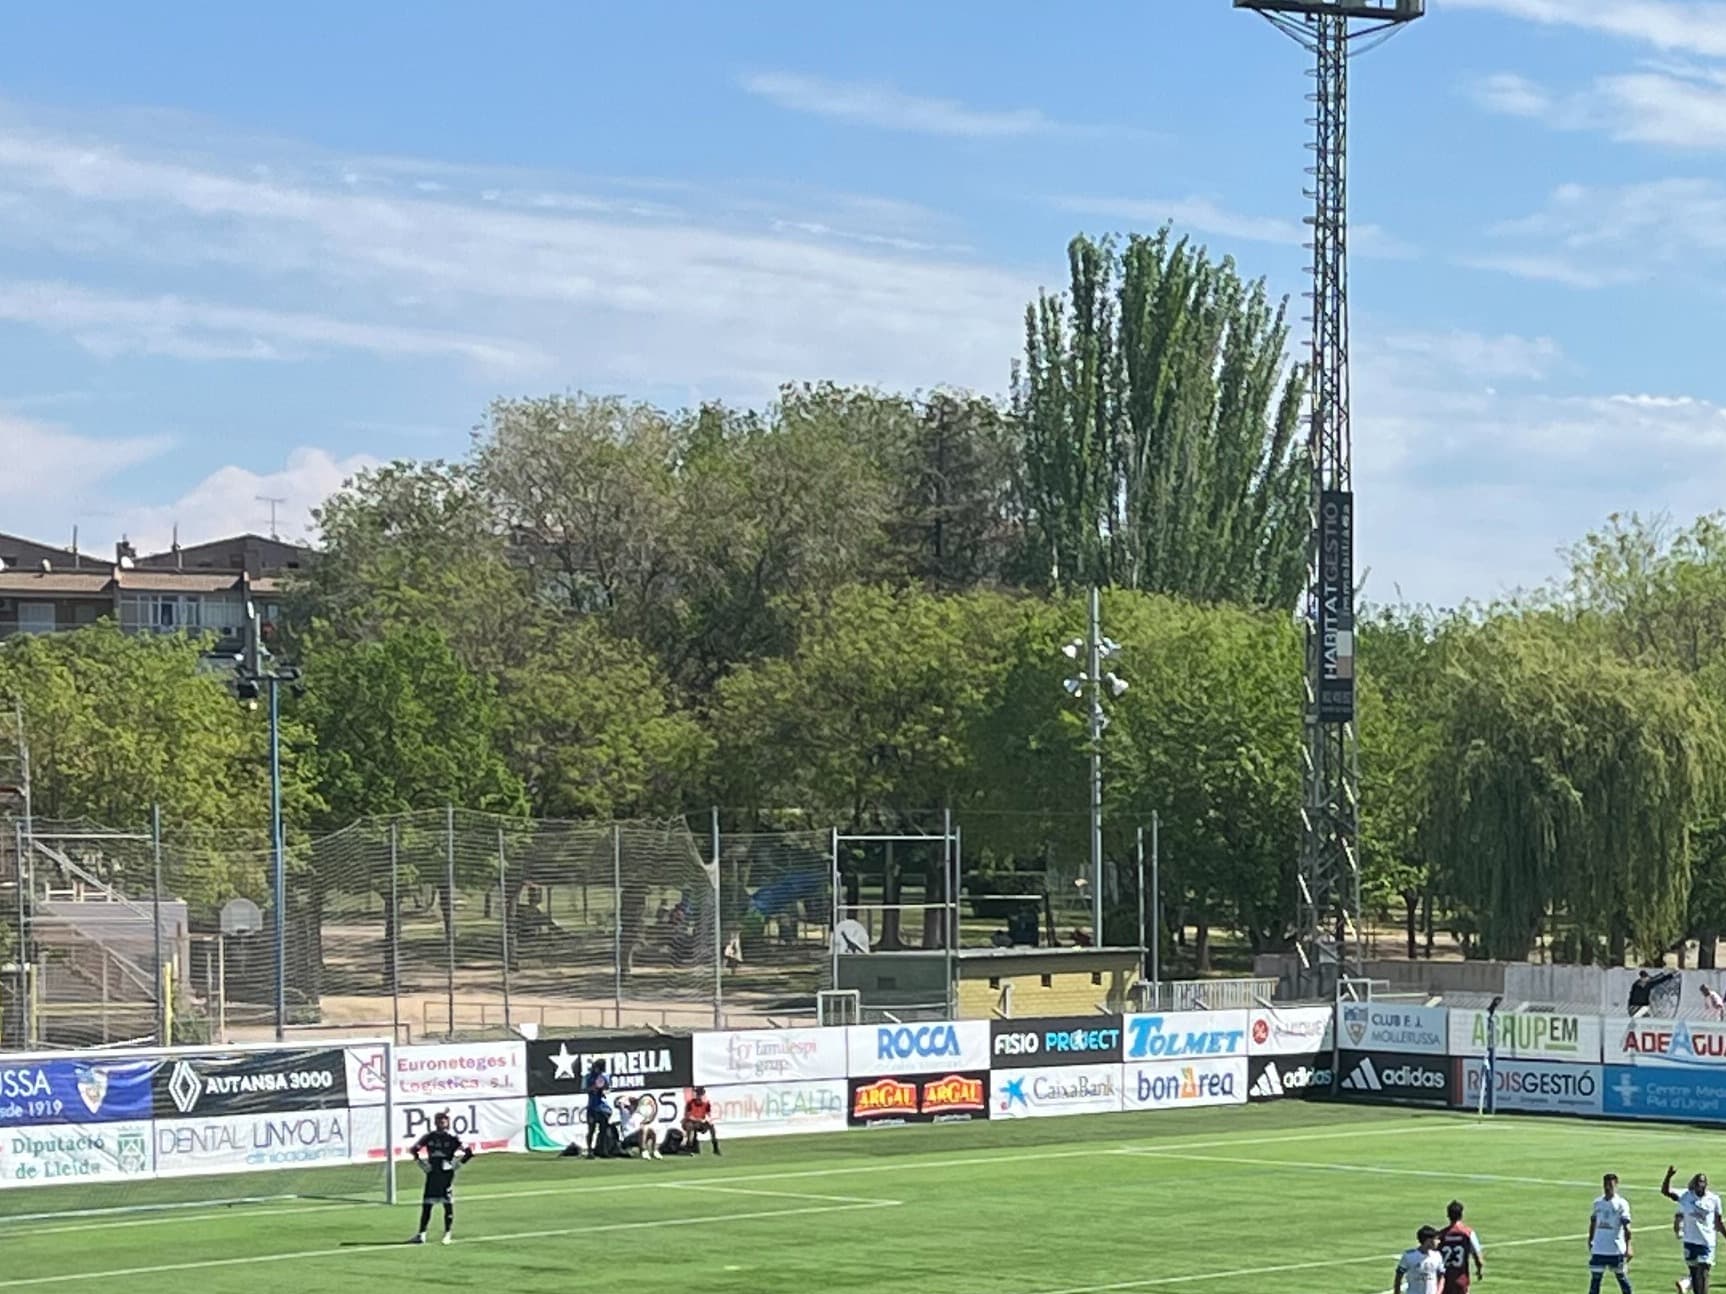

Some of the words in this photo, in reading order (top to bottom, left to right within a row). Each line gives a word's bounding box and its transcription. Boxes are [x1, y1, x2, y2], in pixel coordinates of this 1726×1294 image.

[877, 1025, 961, 1060] ROCCA
[580, 1050, 673, 1076] ETRELLA
[0, 1069, 53, 1098] SSA
[205, 1072, 289, 1094] AUTANSA
[290, 1070, 334, 1089] 3000
[1032, 1072, 1115, 1100] CaixaBank
[1283, 1066, 1332, 1089] adidas
[1381, 1067, 1445, 1089] adidas
[859, 1084, 912, 1108] ARGAL
[926, 1081, 977, 1104] ARGAL
[28, 1099, 63, 1117] 1919
[159, 1124, 247, 1155] DENTAL
[252, 1117, 344, 1149] LINYOLA
[15, 1162, 38, 1180] de
